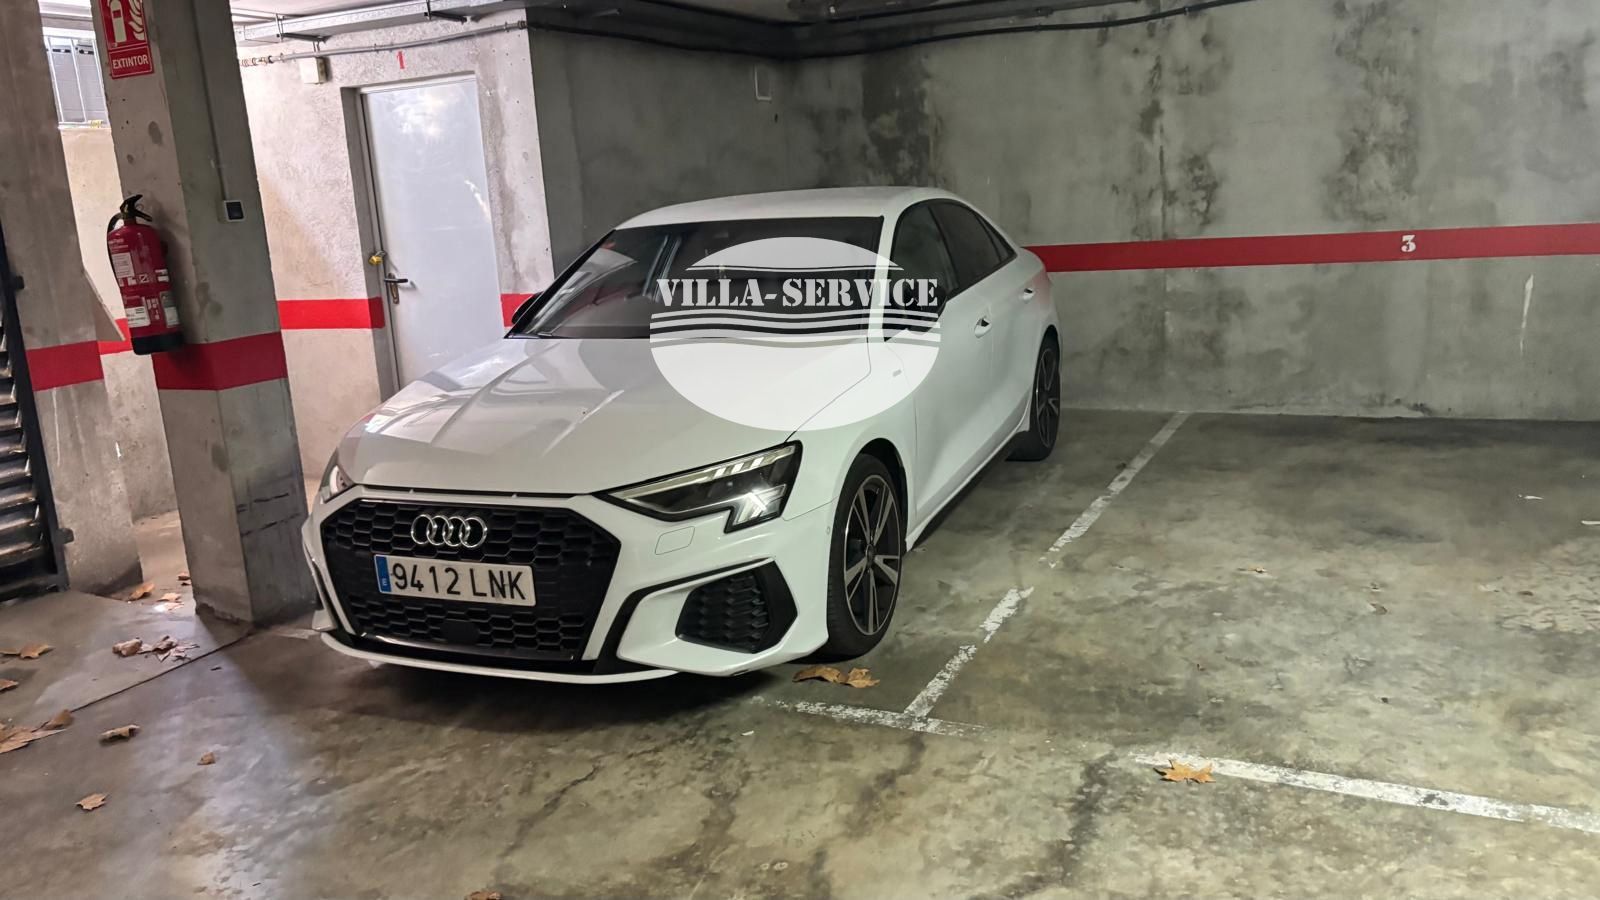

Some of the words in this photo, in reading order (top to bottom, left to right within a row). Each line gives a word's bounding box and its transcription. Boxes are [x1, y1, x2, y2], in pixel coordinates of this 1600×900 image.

[112, 54, 149, 69] EXTINTOR
[1401, 234, 1417, 252] 3
[391, 562, 461, 596] 9412
[469, 567, 526, 600] LNK
